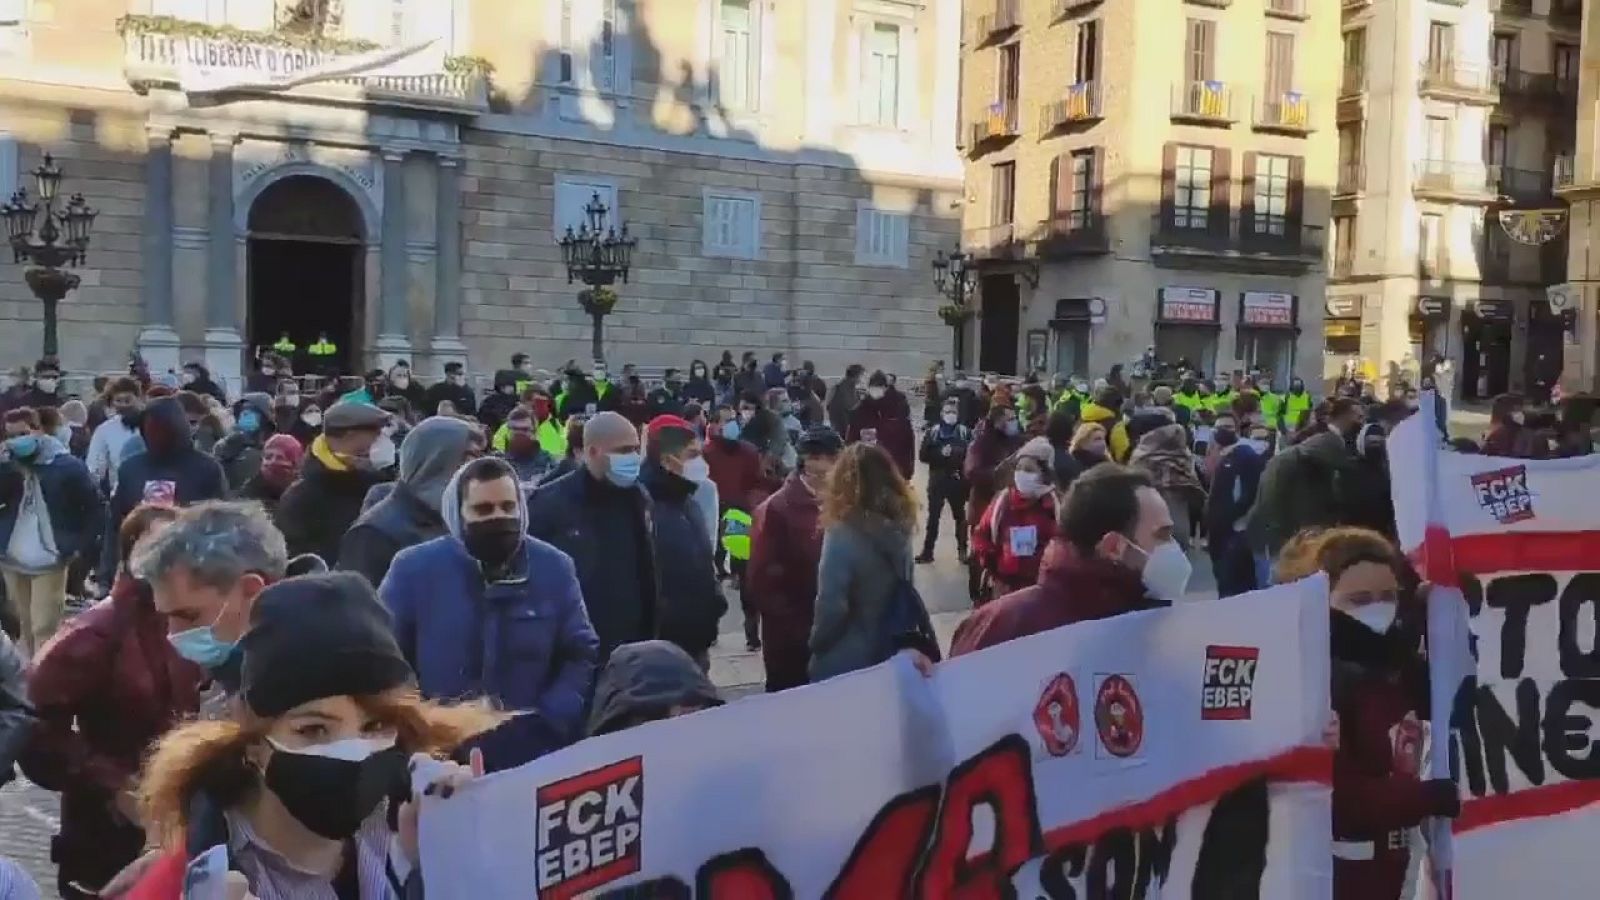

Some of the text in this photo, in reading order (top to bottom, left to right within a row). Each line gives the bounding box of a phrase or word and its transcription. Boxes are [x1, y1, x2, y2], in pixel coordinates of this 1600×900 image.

[186, 38, 262, 70] LLIBERTAT
[1475, 474, 1528, 504] FCK
[1461, 572, 1600, 680] TO
[1205, 659, 1256, 685] FCK
[1204, 686, 1251, 709] EBEP
[540, 775, 640, 851] FCK
[540, 822, 640, 890] EBEP
